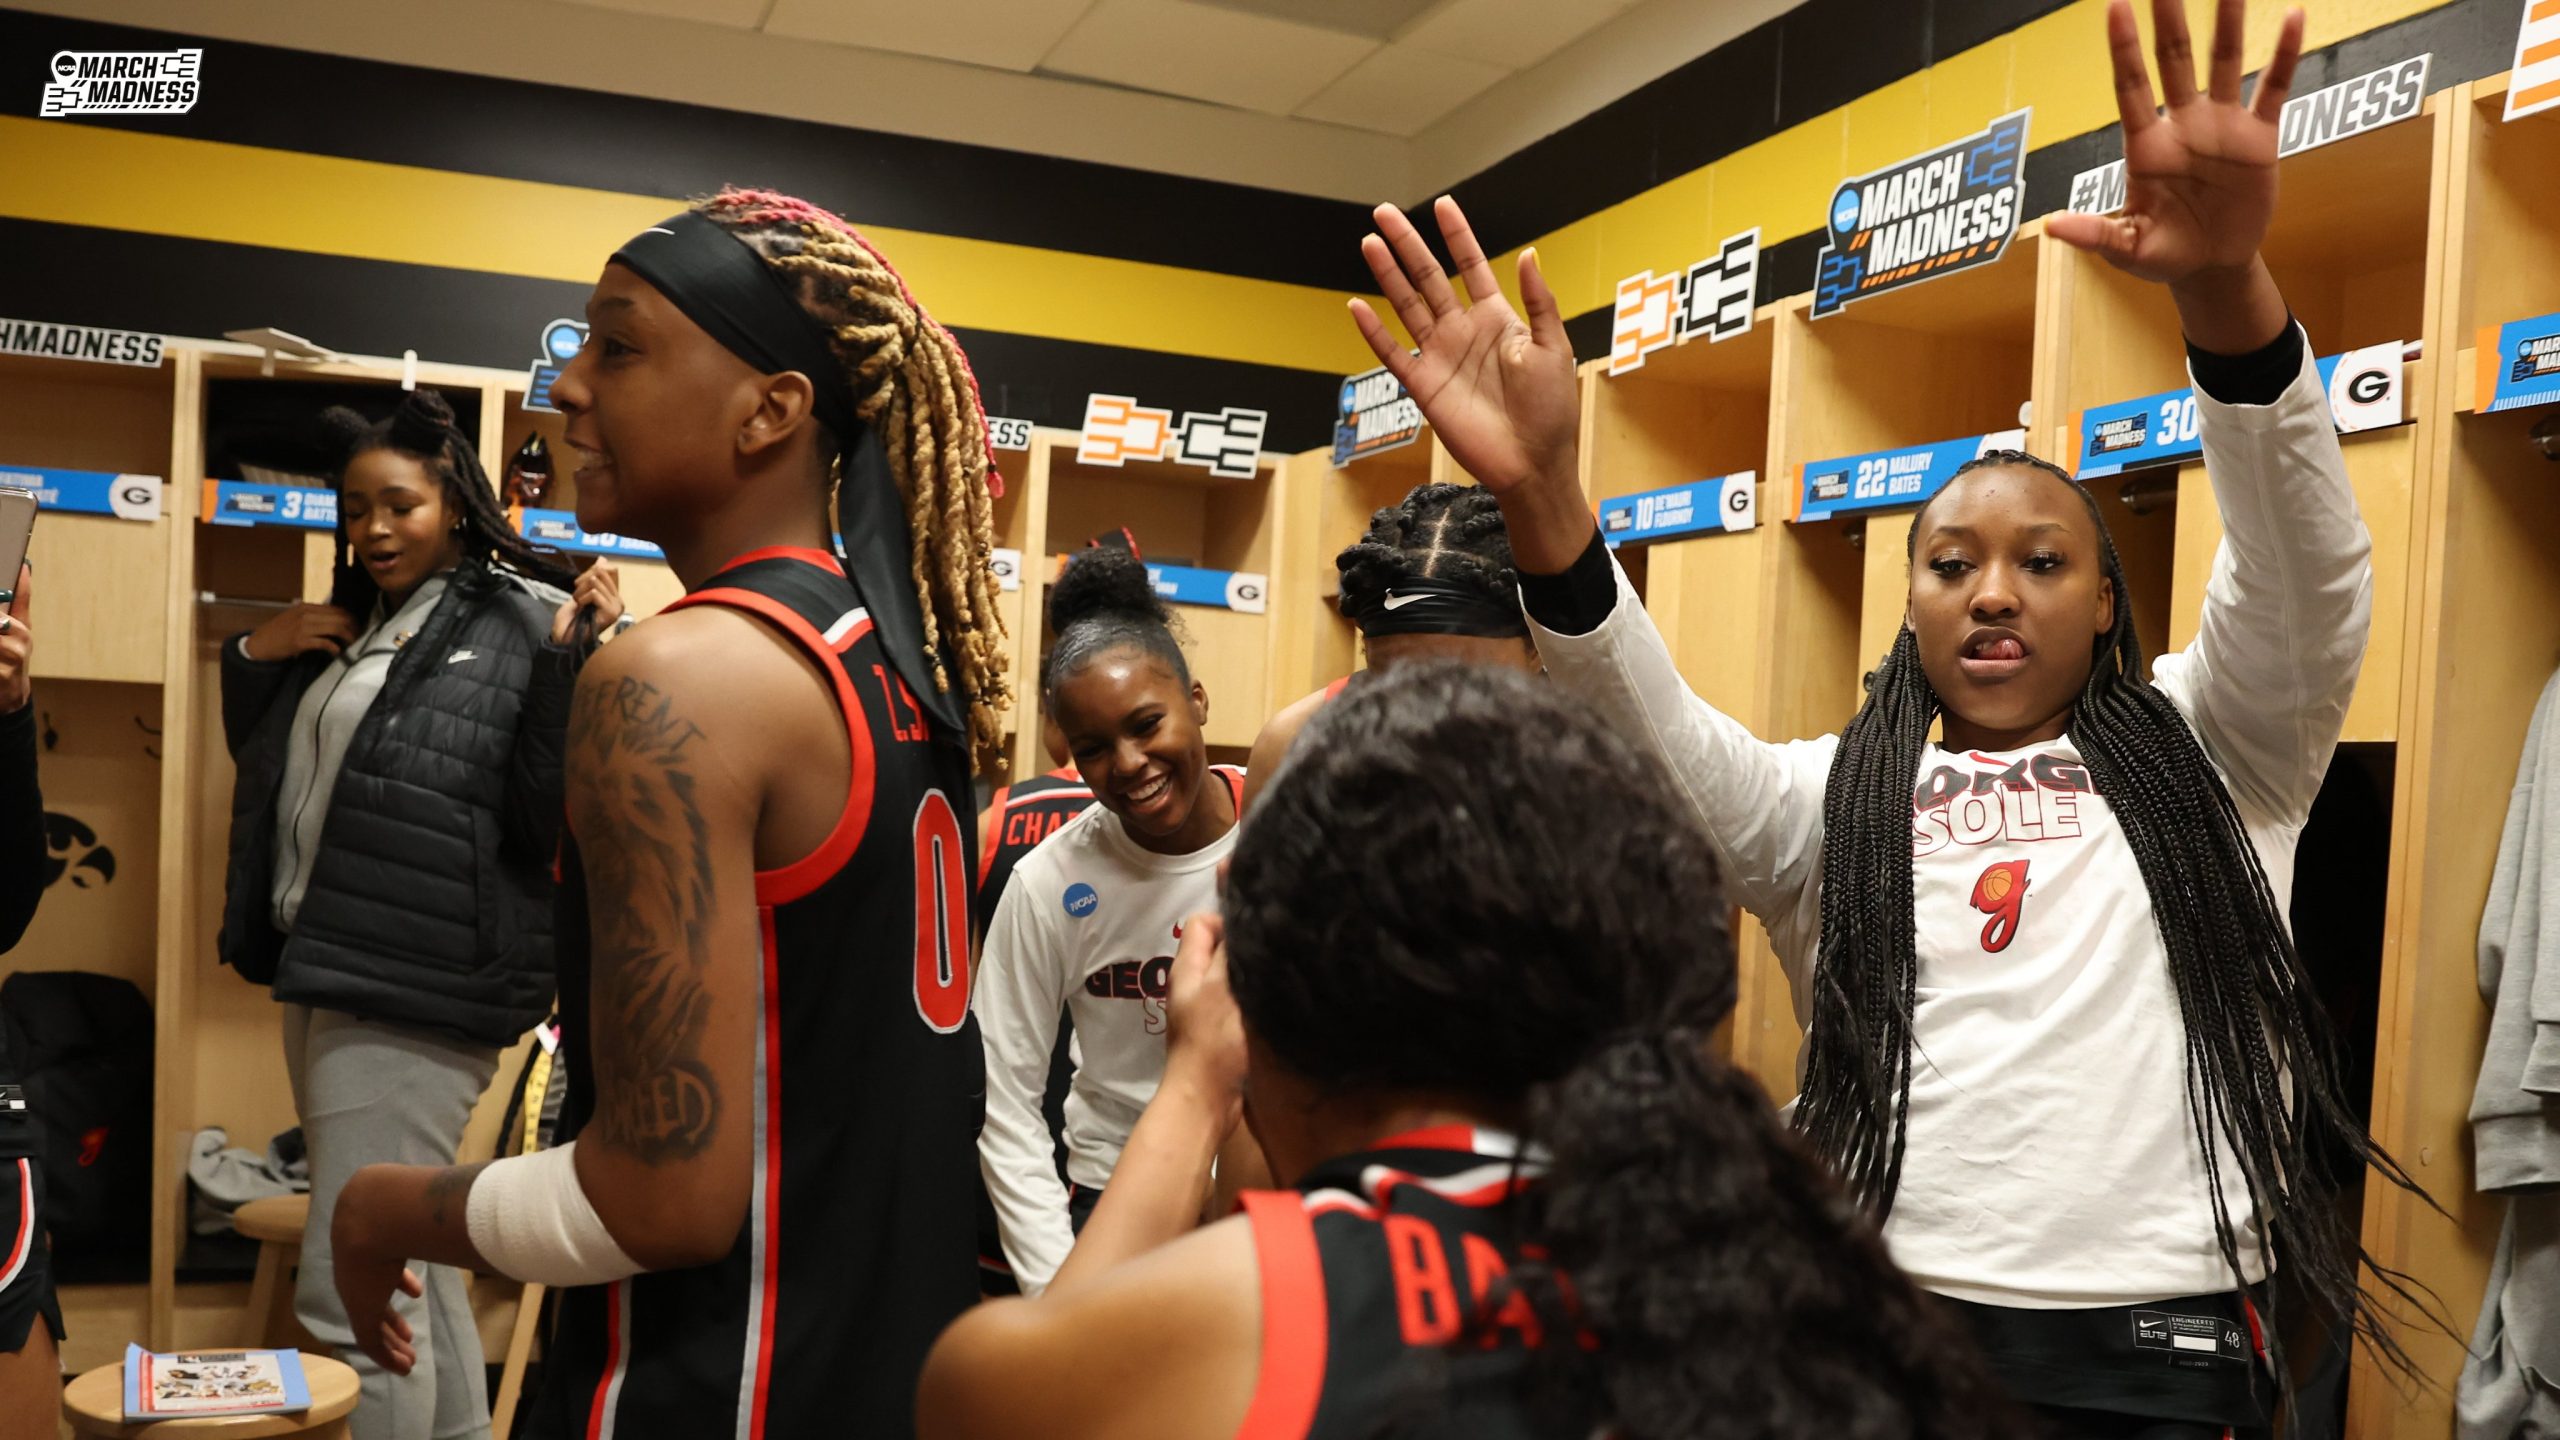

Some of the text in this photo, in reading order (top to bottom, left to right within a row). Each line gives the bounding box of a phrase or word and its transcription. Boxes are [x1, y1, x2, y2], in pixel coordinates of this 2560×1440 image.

[1858, 152, 1964, 231] MARCH
[1867, 186, 2014, 275] MADNESS
[2349, 371, 2390, 404] G
[1356, 397, 1420, 442] MADNESS
[2156, 396, 2200, 446] 30
[1855, 458, 1889, 499] 22
[1888, 474, 1922, 496] BATES
[122, 487, 152, 505] G
[281, 491, 303, 519] 3
[1729, 490, 1749, 512] G
[1636, 497, 1655, 531] 10
[1006, 811, 1082, 846] CHA
[913, 788, 971, 1034] 0
[1070, 893, 1097, 912] NCAA
[1085, 956, 1176, 999] GEO
[2224, 1330, 2240, 1349] 48
